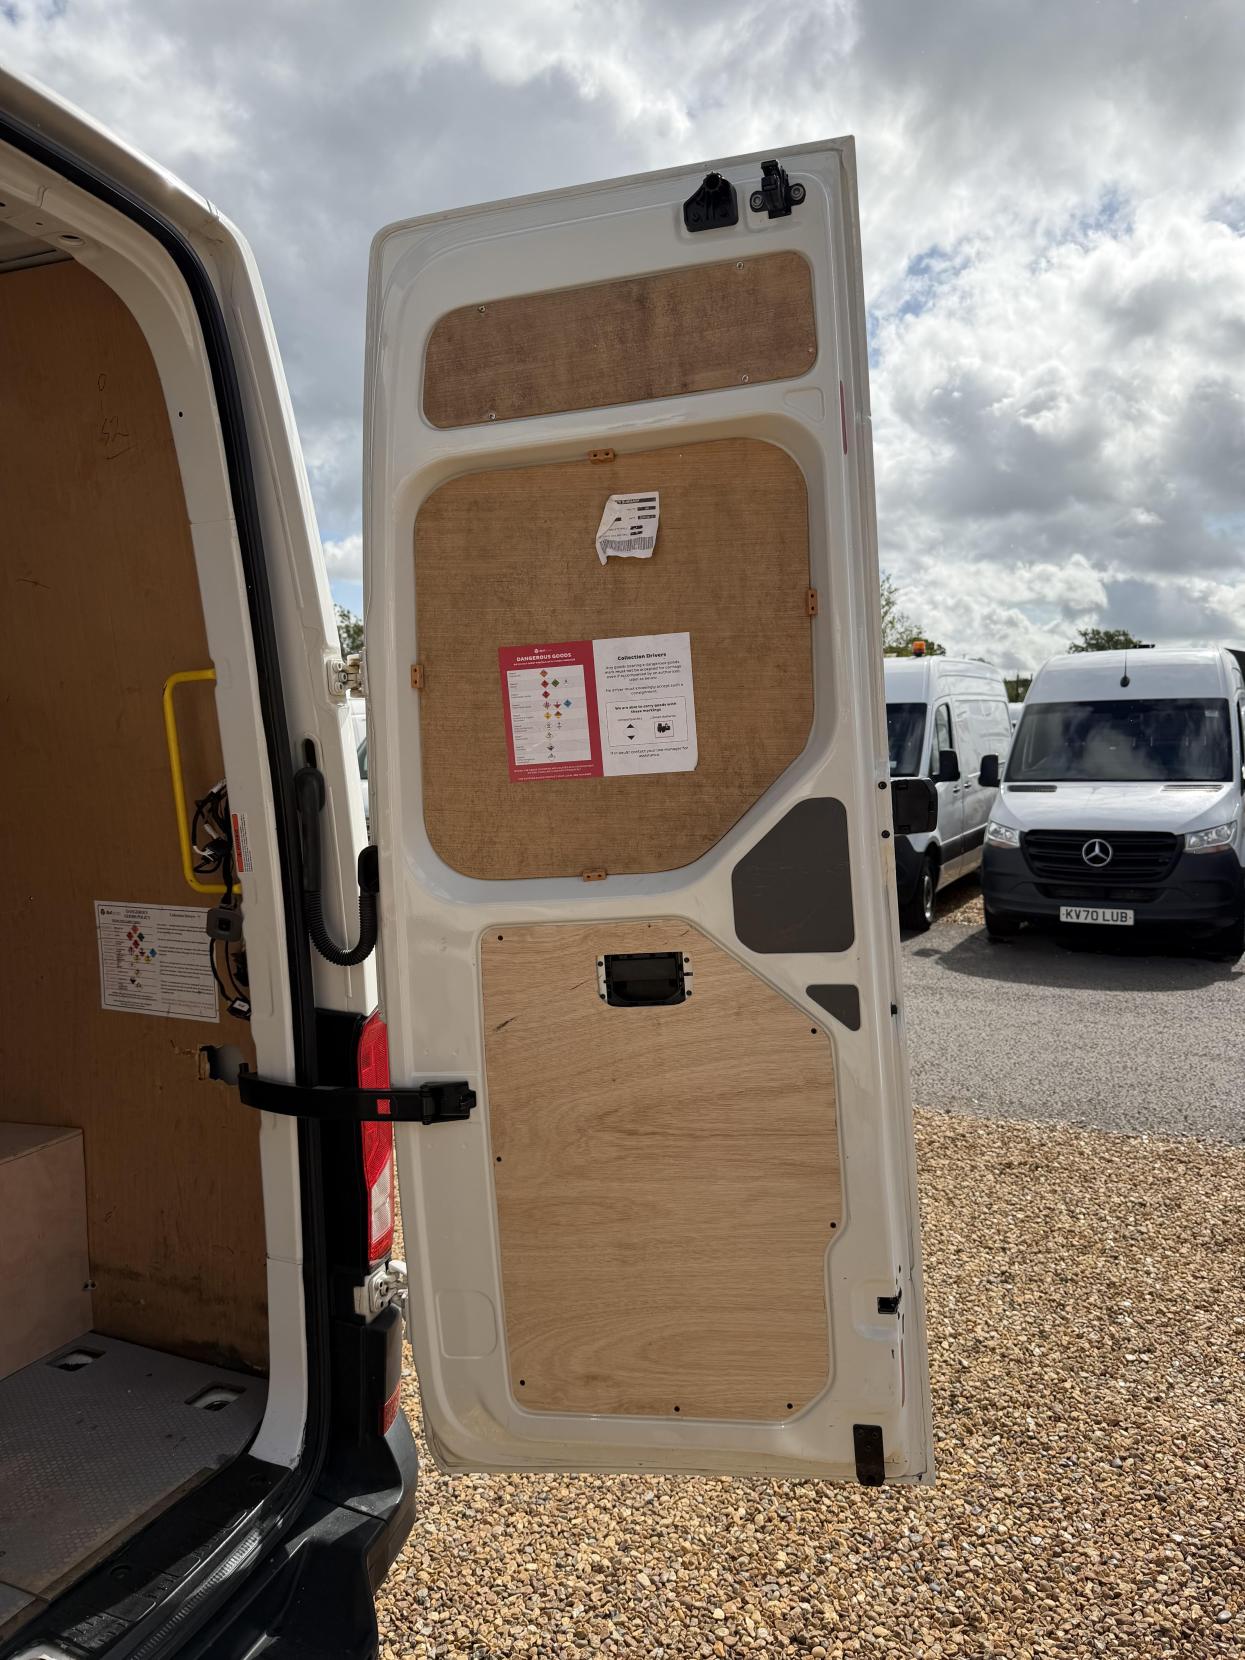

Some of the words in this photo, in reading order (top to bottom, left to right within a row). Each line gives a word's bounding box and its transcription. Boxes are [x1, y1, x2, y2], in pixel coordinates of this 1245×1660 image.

[516, 654, 551, 662] DANGEROUS
[617, 653, 645, 661] Collection
[1065, 908, 1099, 921] KV70
[1102, 910, 1128, 923] LUB
